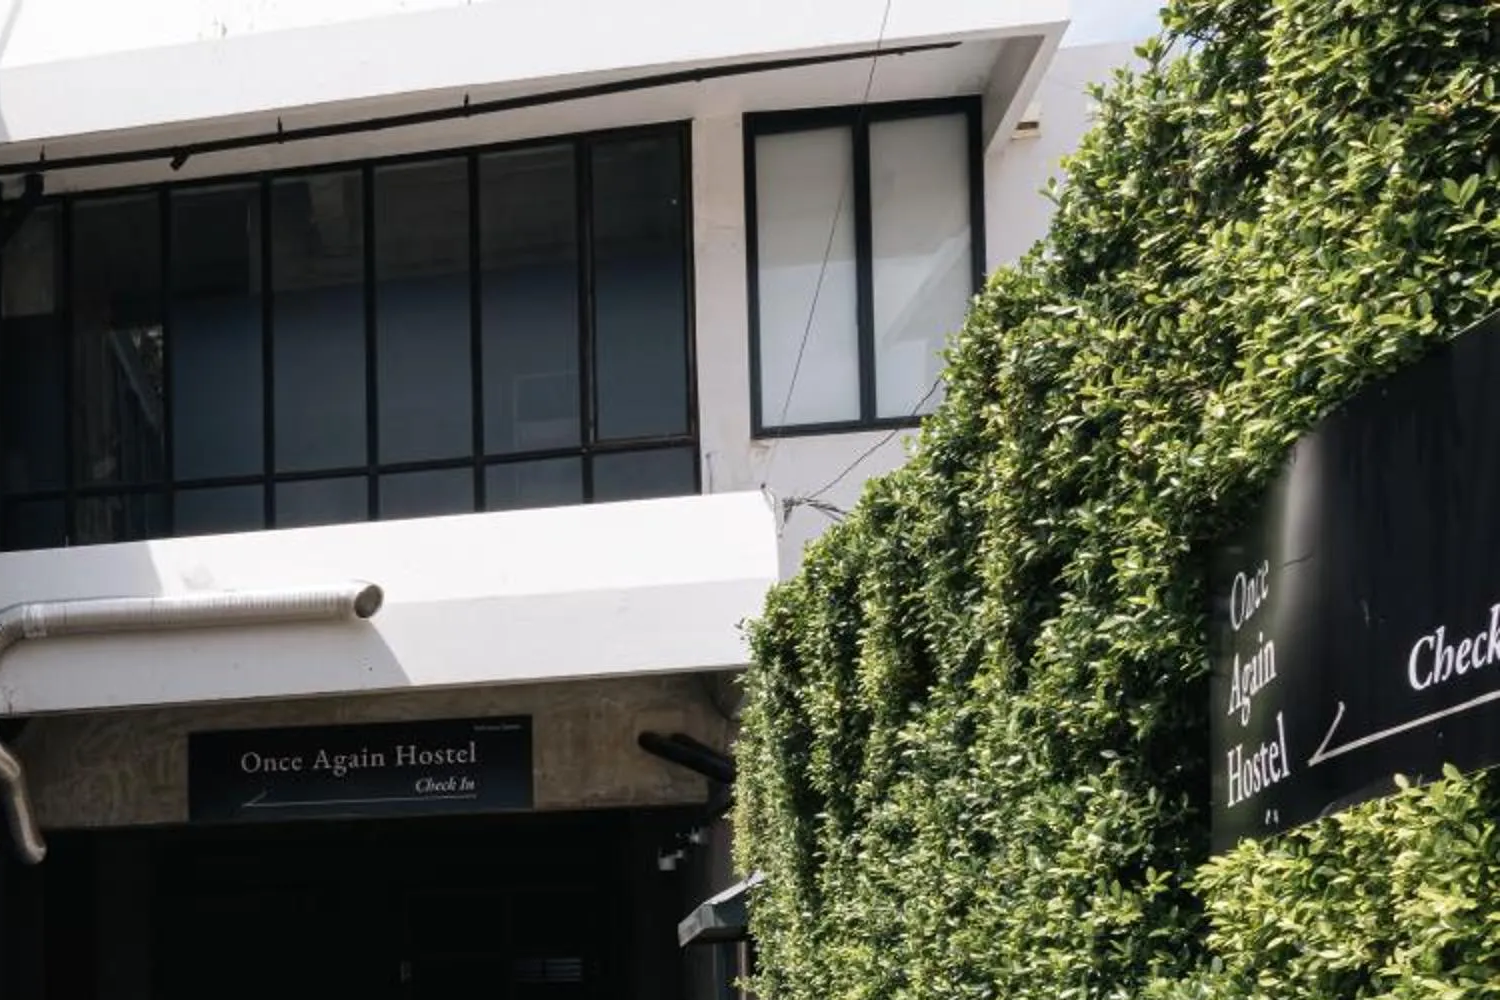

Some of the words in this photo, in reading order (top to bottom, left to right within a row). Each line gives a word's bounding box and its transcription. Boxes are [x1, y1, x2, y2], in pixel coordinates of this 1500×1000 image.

[1230, 559, 1269, 631] Once
[1228, 632, 1277, 727] Again
[240, 751, 303, 773] Once
[312, 748, 385, 777] Again
[395, 741, 477, 766] Hostel
[415, 776, 457, 793] Check
[460, 775, 475, 791] In
[1227, 710, 1290, 808] Hostel
